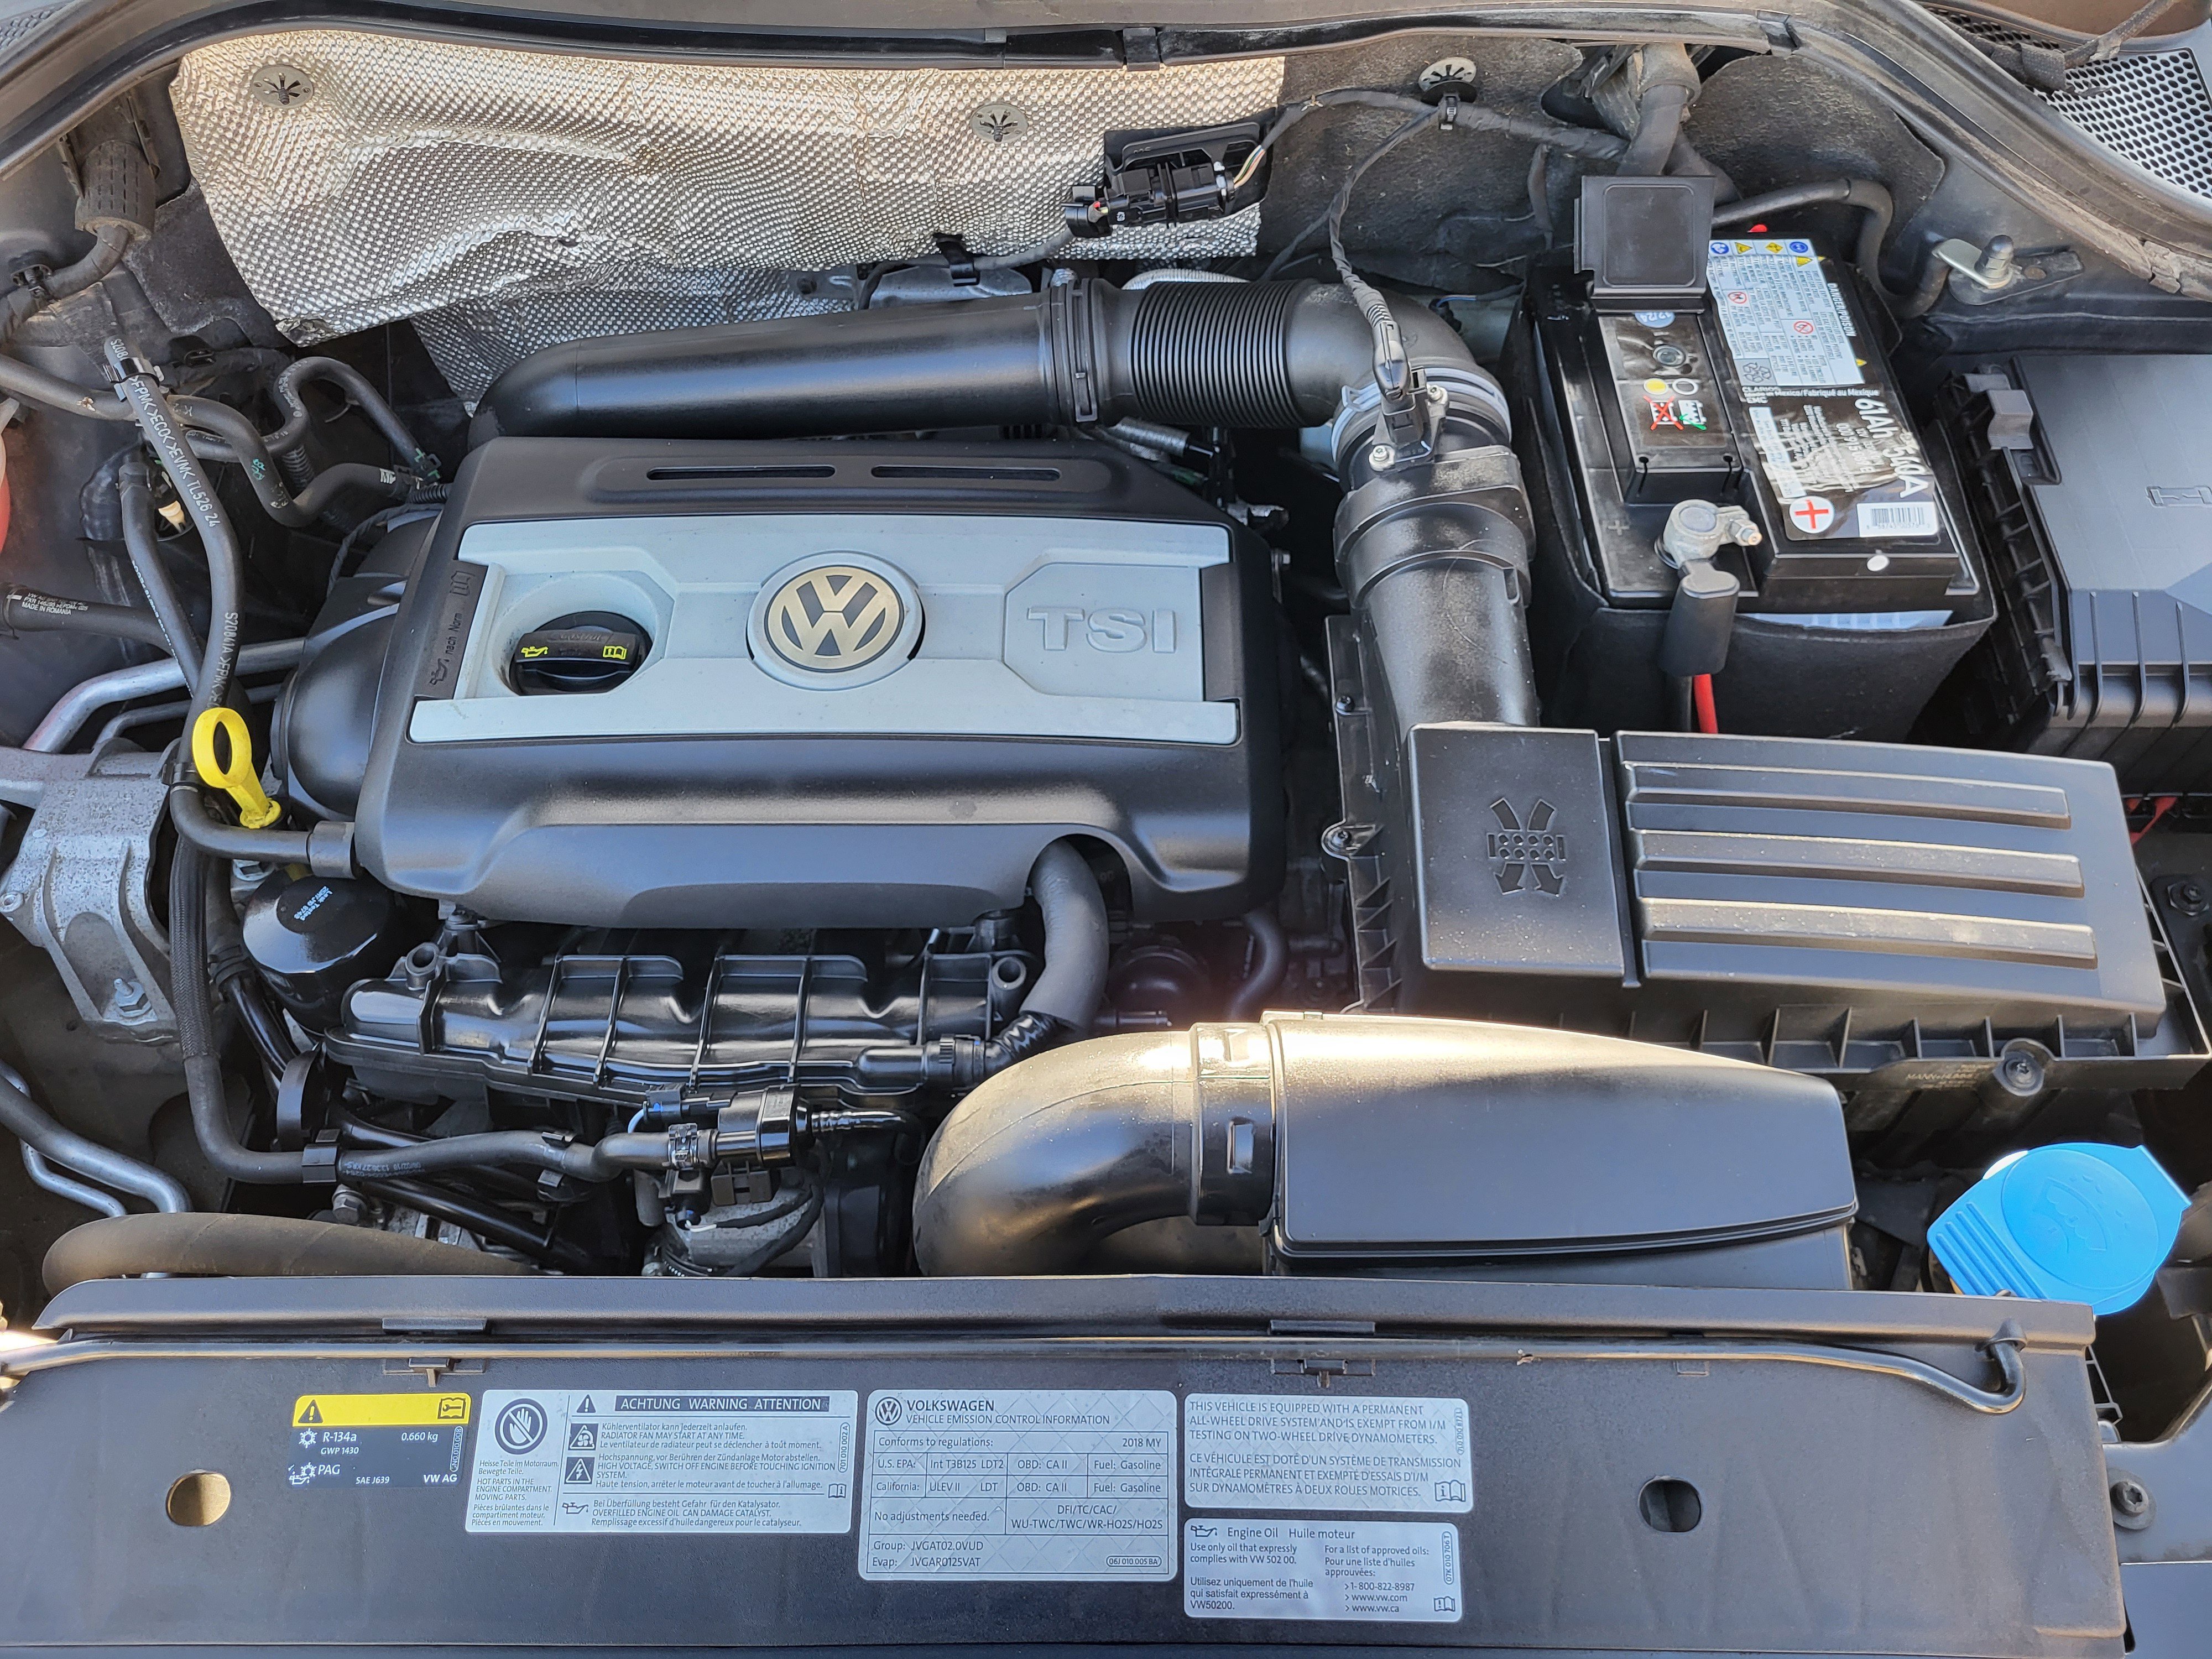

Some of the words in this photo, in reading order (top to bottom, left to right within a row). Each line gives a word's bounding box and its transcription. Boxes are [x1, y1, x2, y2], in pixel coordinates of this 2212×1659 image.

[1827, 283, 1857, 337] DANGER/POISON
[1855, 398, 1900, 439] 61Ah
[1882, 447, 1929, 498] 540A
[187, 480, 213, 512] TL526
[205, 513, 221, 527] 24
[22, 602, 38, 611] MADE
[1027, 606, 1177, 654] TSI
[445, 637, 457, 655] nach
[620, 1398, 681, 1410] ACHTUNG
[689, 1399, 748, 1410] WARNING
[754, 1399, 821, 1410] ATTENTION
[907, 1400, 994, 1411] VOLKSWAGEN
[1190, 1401, 1213, 1411] THIS
[1215, 1402, 1256, 1412] VEHICLE
[1259, 1403, 1267, 1411] IS
[1270, 1403, 1319, 1415] EQUIPPED
[1323, 1404, 1349, 1414] WITH
[1353, 1405, 1360, 1413] A
[1362, 1405, 1423, 1415] PERMANENT
[947, 1415, 992, 1423] EMISSION
[995, 1415, 1040, 1423] CONTROL
[1042, 1415, 1110, 1424] INFORMATION
[1190, 1416, 1245, 1426] ALL-WHEEL
[1248, 1417, 1277, 1427] DRIVE
[1280, 1417, 1317, 1427] SYSTEM
[1319, 1418, 1343, 1428] AND
[1346, 1419, 1354, 1428] IS
[1357, 1419, 1395, 1428] EXEMPT
[1399, 1420, 1426, 1429] FROM
[1430, 1420, 1446, 1430] I/M
[680, 1423, 712, 1432] jederzeit
[323, 1432, 357, 1442] R-134a
[401, 1432, 425, 1441] 0.660
[427, 1432, 439, 1442] kg
[879, 1437, 924, 1446] Conforms
[938, 1437, 993, 1448] regulations:
[1123, 1438, 1143, 1447] 2018
[1146, 1438, 1161, 1447] MY
[1190, 1430, 1231, 1440] TESTING
[1234, 1431, 1250, 1440] ON
[1253, 1431, 1316, 1442] TWO-WHEEL
[1319, 1432, 1352, 1442] DRIVE
[1352, 1433, 1437, 1444] DYNAMOMETERS.
[317, 1464, 341, 1475] PAG
[930, 1460, 943, 1468] Int
[946, 1460, 977, 1469] T3B125
[981, 1460, 1004, 1469] LDT2
[1018, 1460, 1041, 1469] OBD:
[1046, 1460, 1060, 1469] CA
[1062, 1460, 1067, 1469] II
[1094, 1460, 1116, 1469] Fuel:
[1120, 1460, 1161, 1470] Gasoline
[372, 1476, 390, 1484] J639
[423, 1475, 441, 1483] VW
[442, 1474, 458, 1483] AG
[1057, 1505, 1117, 1515] DFI/TC/CAC/
[874, 1511, 888, 1521] No
[890, 1511, 950, 1523] adjustments
[952, 1511, 989, 1521] needed.
[1011, 1519, 1163, 1529] WU-TWC/TWC/WR-HO2S/HO2S
[1228, 1527, 1261, 1540] Engine
[1264, 1527, 1278, 1537] Oil
[1289, 1528, 1315, 1538] Huile
[1318, 1529, 1355, 1539] moteur
[874, 1541, 905, 1552] Group:
[912, 1541, 983, 1551] JVGAT02.0VUD
[1208, 1543, 1225, 1553] only
[1228, 1543, 1237, 1552] oil
[1240, 1543, 1257, 1552] that
[1259, 1543, 1297, 1554] expressly
[872, 1557, 897, 1568] Evap:
[910, 1557, 981, 1567] JVGAR0125VAT
[1191, 1554, 1227, 1565] complies
[1229, 1554, 1248, 1563] with
[1284, 1556, 1297, 1564] 00.
[1191, 1600, 1235, 1610] VW50200.
